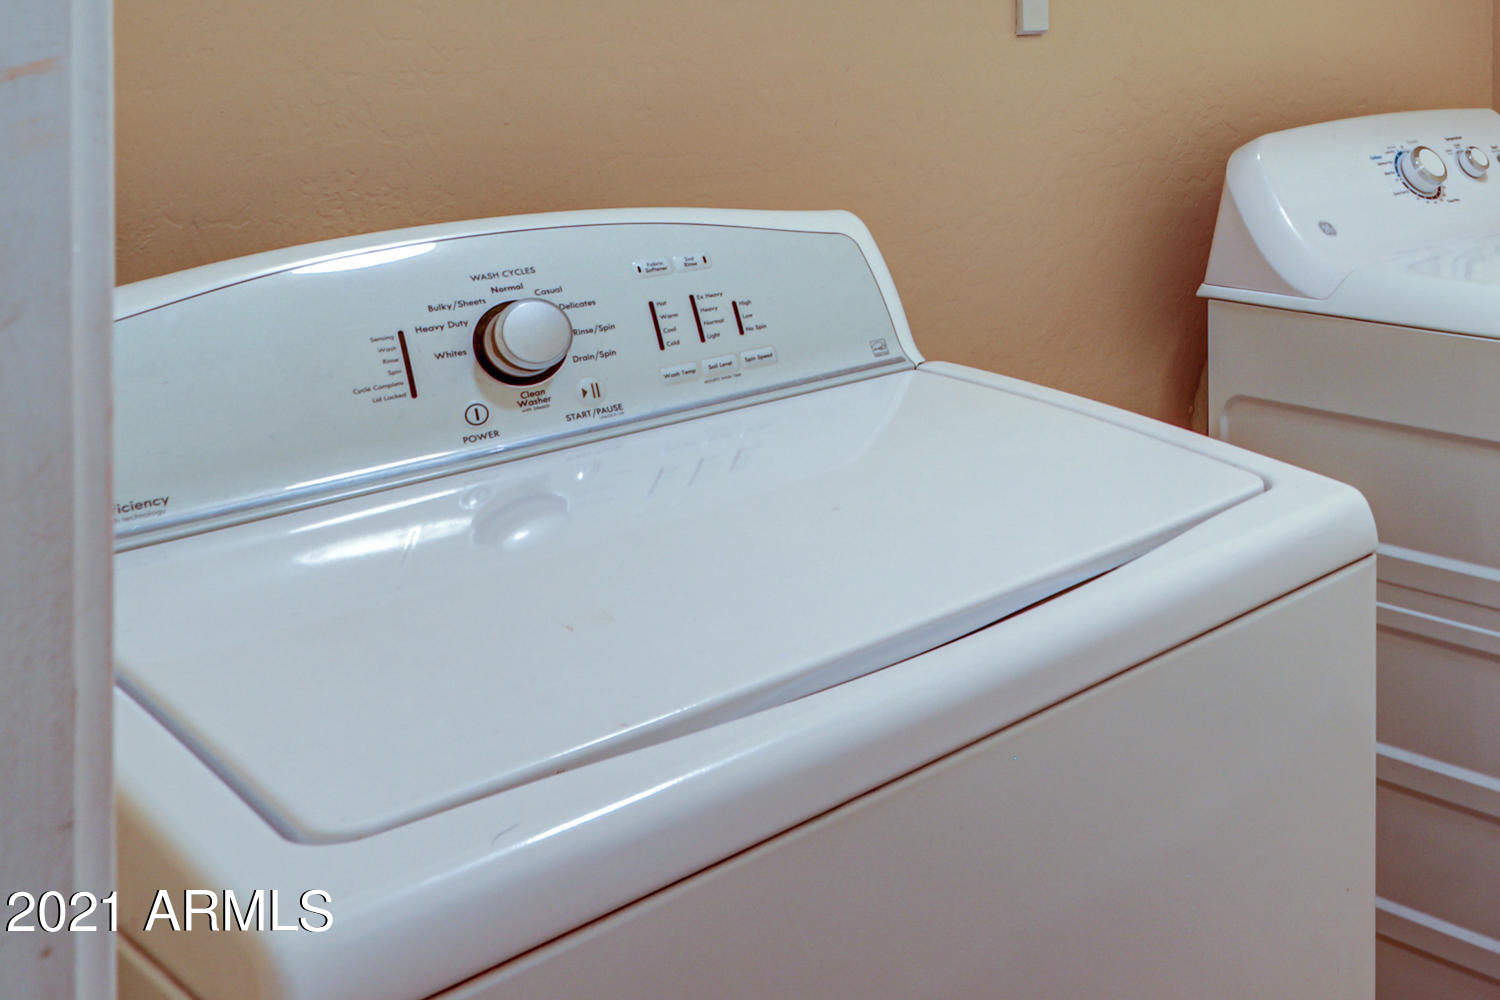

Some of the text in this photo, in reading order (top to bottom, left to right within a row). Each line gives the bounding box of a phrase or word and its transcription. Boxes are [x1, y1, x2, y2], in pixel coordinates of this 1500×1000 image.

[470, 266, 537, 281] WASH CYCLES
[490, 282, 525, 294] Normal
[534, 286, 563, 297] Casual
[427, 299, 487, 313] Bulky/Sheets
[558, 300, 597, 311] Delicates
[414, 319, 469, 334] Heavy Duty
[572, 323, 616, 336] Rinse/Spin
[666, 339, 680, 347] Cold
[433, 349, 468, 360] Whites
[572, 349, 617, 363] Drain/Spin
[757, 351, 773, 361] Speed
[719, 360, 733, 368] Level
[664, 368, 697, 379] Wash Temp
[519, 388, 546, 400] Clean
[516, 396, 551, 408] Washer
[565, 403, 624, 423] START/PAUSE
[462, 429, 500, 444] POWER
